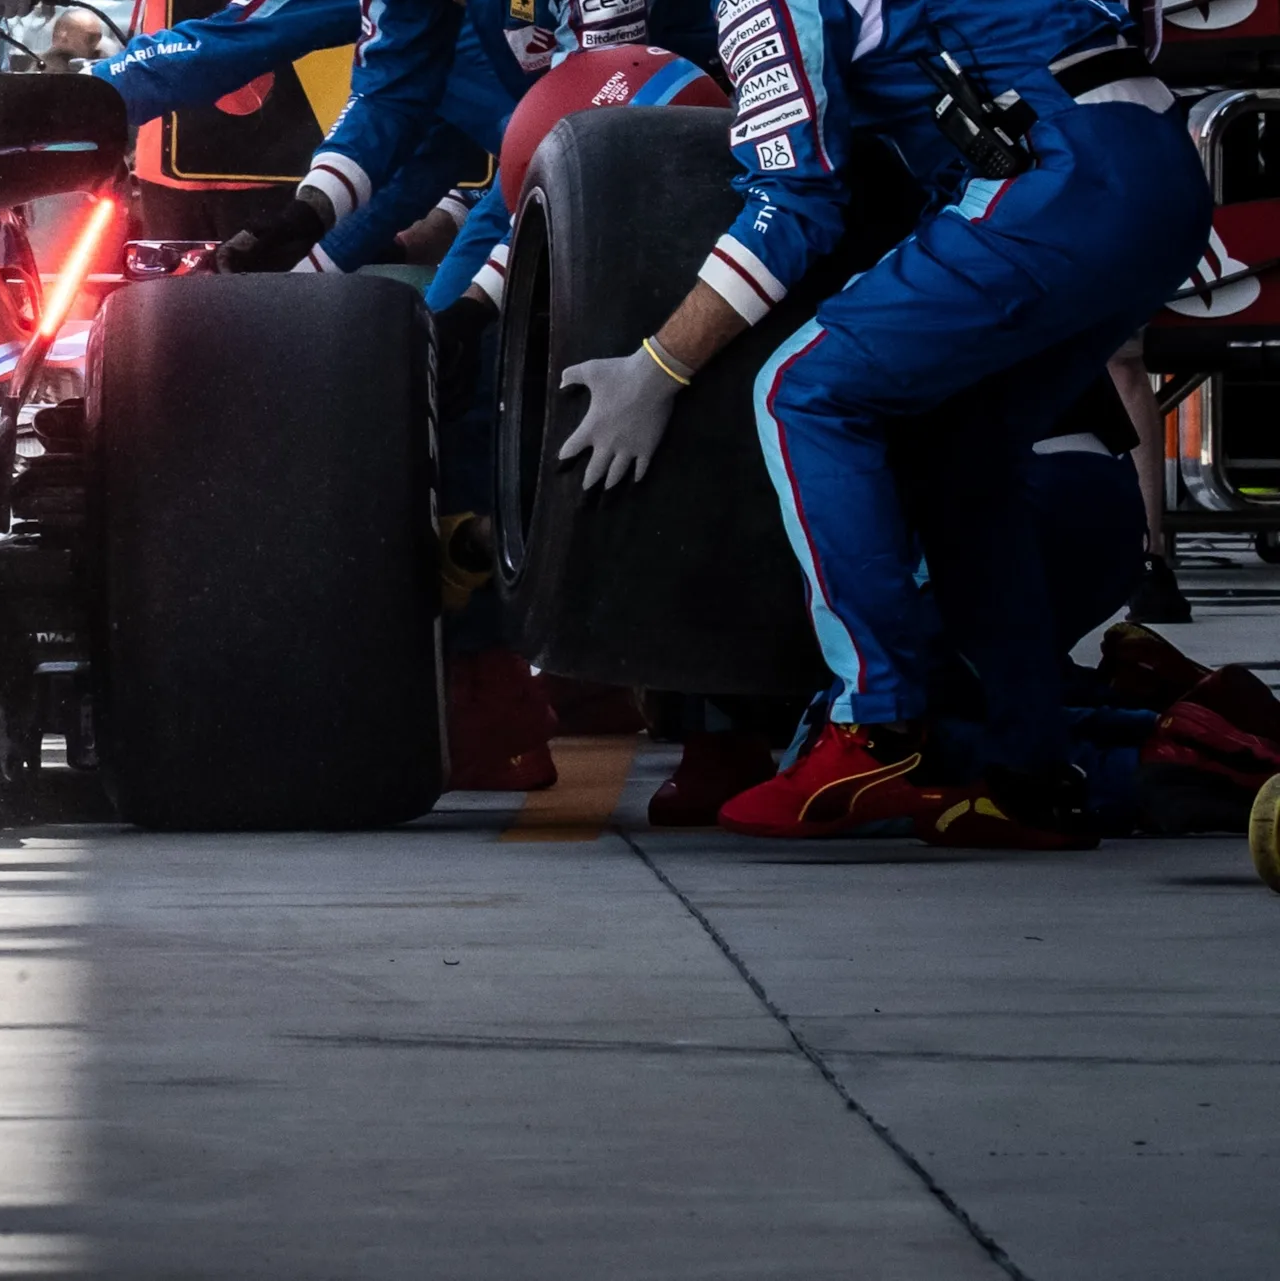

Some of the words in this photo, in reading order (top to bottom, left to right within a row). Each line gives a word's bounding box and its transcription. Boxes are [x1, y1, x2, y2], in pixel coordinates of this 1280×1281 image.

[585, 23, 646, 46] Bitdefender
[722, 16, 772, 61] Bitdefender
[591, 70, 626, 106] PERONI
[739, 67, 789, 101] ARMAN
[750, 107, 803, 133] ManpowerGroup
